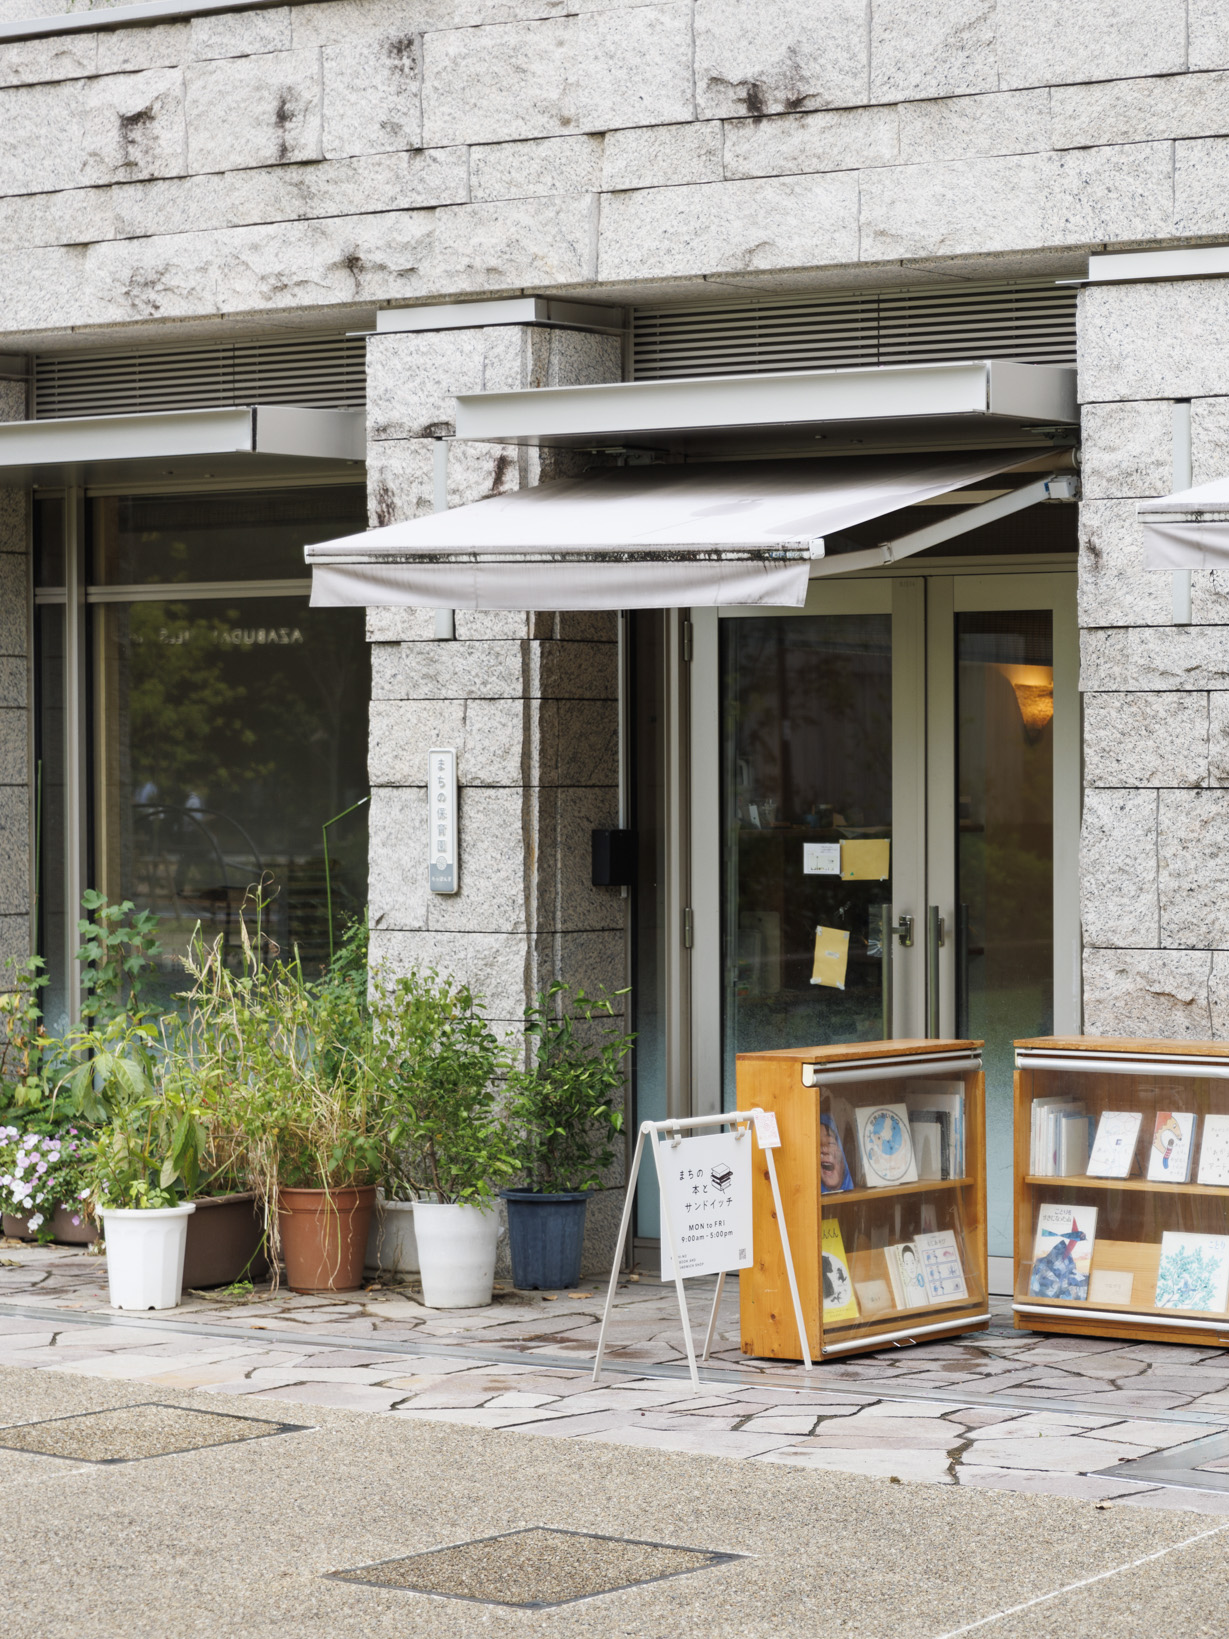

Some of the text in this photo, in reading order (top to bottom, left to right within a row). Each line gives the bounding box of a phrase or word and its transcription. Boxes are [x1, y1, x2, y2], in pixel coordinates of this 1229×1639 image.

[680, 1169, 704, 1180] まちの
[692, 1184, 708, 1195] 本と
[685, 1197, 733, 1213] サンドイッチ
[689, 1223, 705, 1231] MON
[1208, 1240, 1226, 1250] ことり
